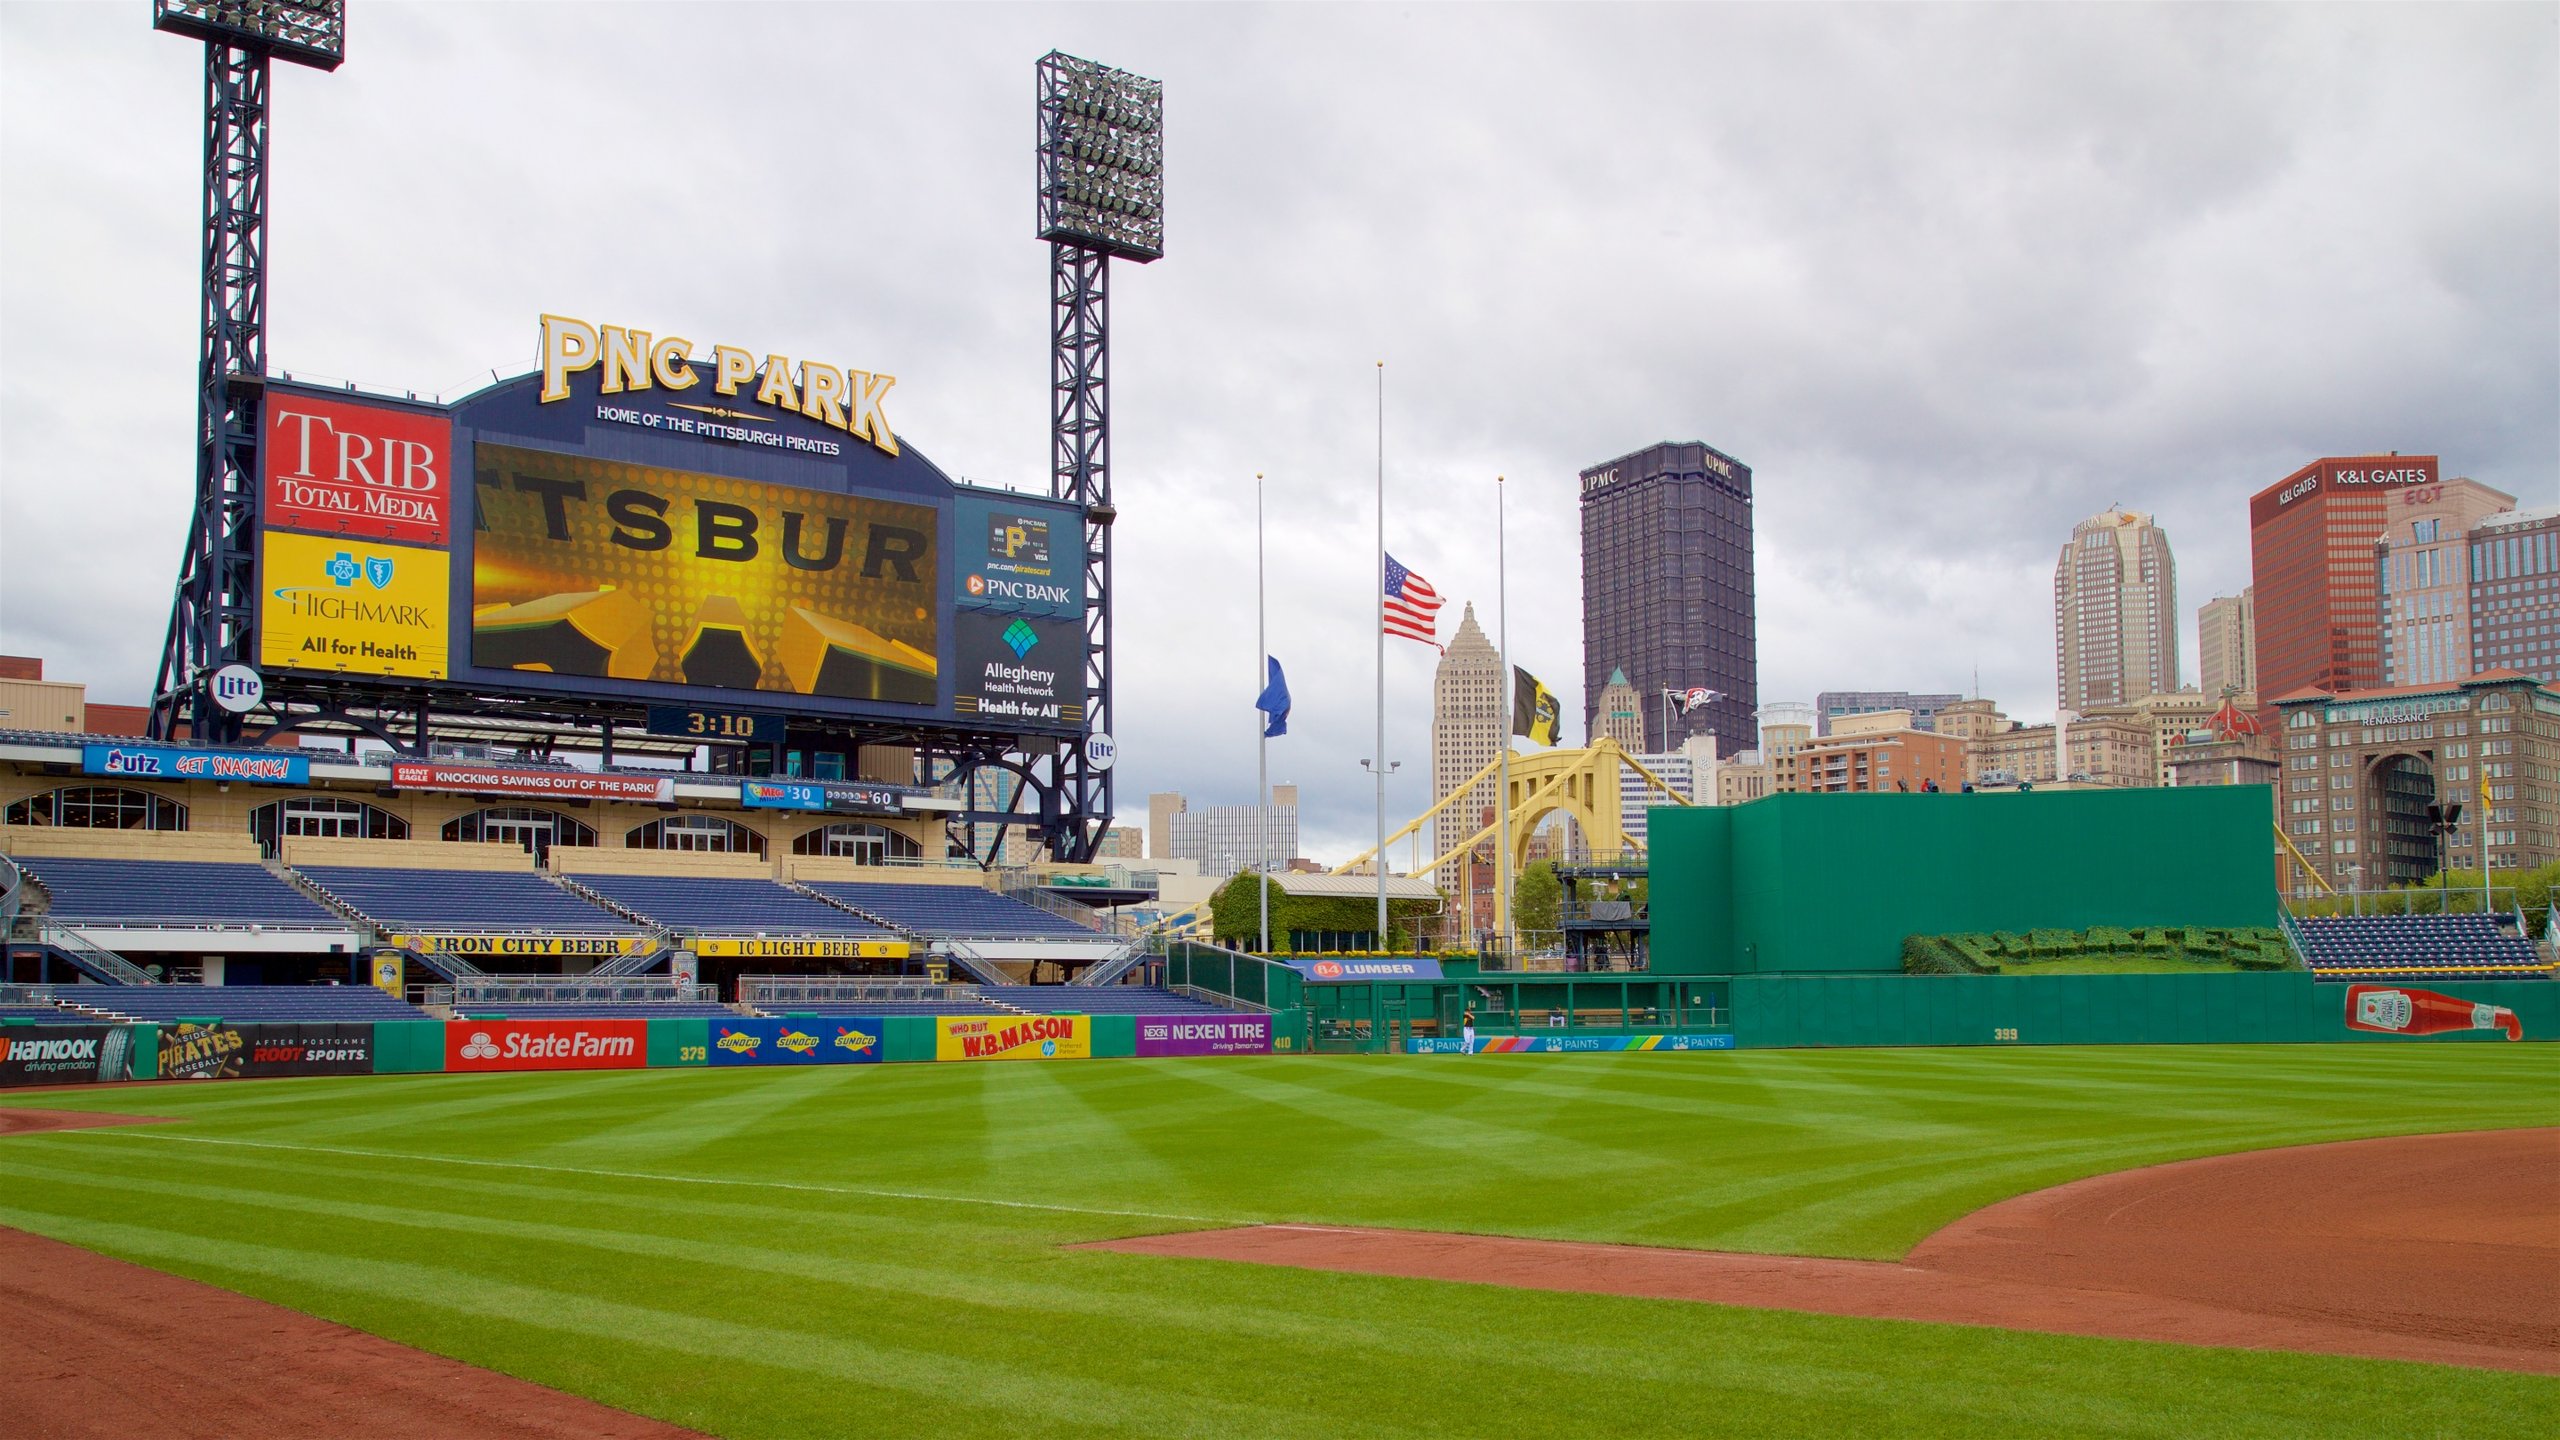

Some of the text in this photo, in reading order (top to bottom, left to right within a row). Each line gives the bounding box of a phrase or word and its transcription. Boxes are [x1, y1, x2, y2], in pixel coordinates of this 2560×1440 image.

[540, 313, 899, 456] PNC PARK
[597, 405, 840, 456] HOME OF THE PITTSBURGH PIRATES
[277, 410, 437, 492] TRIB
[1706, 453, 1732, 479] UPMC
[1581, 468, 1619, 493] UPMC
[2337, 469, 2427, 484] K&L GATES
[2279, 475, 2317, 506] K&L GATES
[2404, 486, 2444, 505] EQT
[278, 479, 438, 522] TOTAL MEDIA
[1034, 553, 1048, 562] VISA
[986, 579, 1070, 604] PNC BANK
[292, 592, 430, 629] HIGHMARK
[302, 636, 417, 661] All for Health
[985, 663, 1055, 686] Allegheny
[218, 675, 259, 700] Lite
[985, 682, 1055, 697] Health Network
[978, 698, 1059, 718] Health for All
[687, 712, 754, 737] 3:10
[2362, 713, 2431, 727] RENAISSANCE
[1088, 741, 1114, 761] Lite
[176, 756, 289, 778] GET SNACKING!
[398, 767, 429, 776] GIANT
[398, 774, 429, 782] EAGLE
[436, 772, 655, 793] KNOCKING SAVINGS OUT OF THE PARK!
[759, 786, 785, 798] MEGA
[434, 937, 620, 953] IRON CITY BEER
[738, 941, 861, 956] IC LIGHT BEER
[1317, 964, 1415, 975] 84 LUMBER
[950, 1022, 988, 1035] WHO BUT
[1173, 1024, 1265, 1039] NEXEN TIRE
[1994, 1028, 2018, 1041] 399
[303, 1038, 366, 1046] POSTGAME
[720, 1038, 760, 1048] SUNOCO
[780, 1037, 818, 1047] SUNOCO
[837, 1036, 875, 1046] SUNOCO
[1213, 1042, 1265, 1051] Driving Tomorrow
[1274, 1037, 1291, 1049] 410
[1565, 1040, 1599, 1049] PAINTS
[1691, 1038, 1725, 1047] PAINTS
[159, 1030, 243, 1076] PIRATES
[254, 1047, 304, 1062] ROOT
[680, 1047, 706, 1061] 379
[25, 1060, 96, 1073] driving emotion
